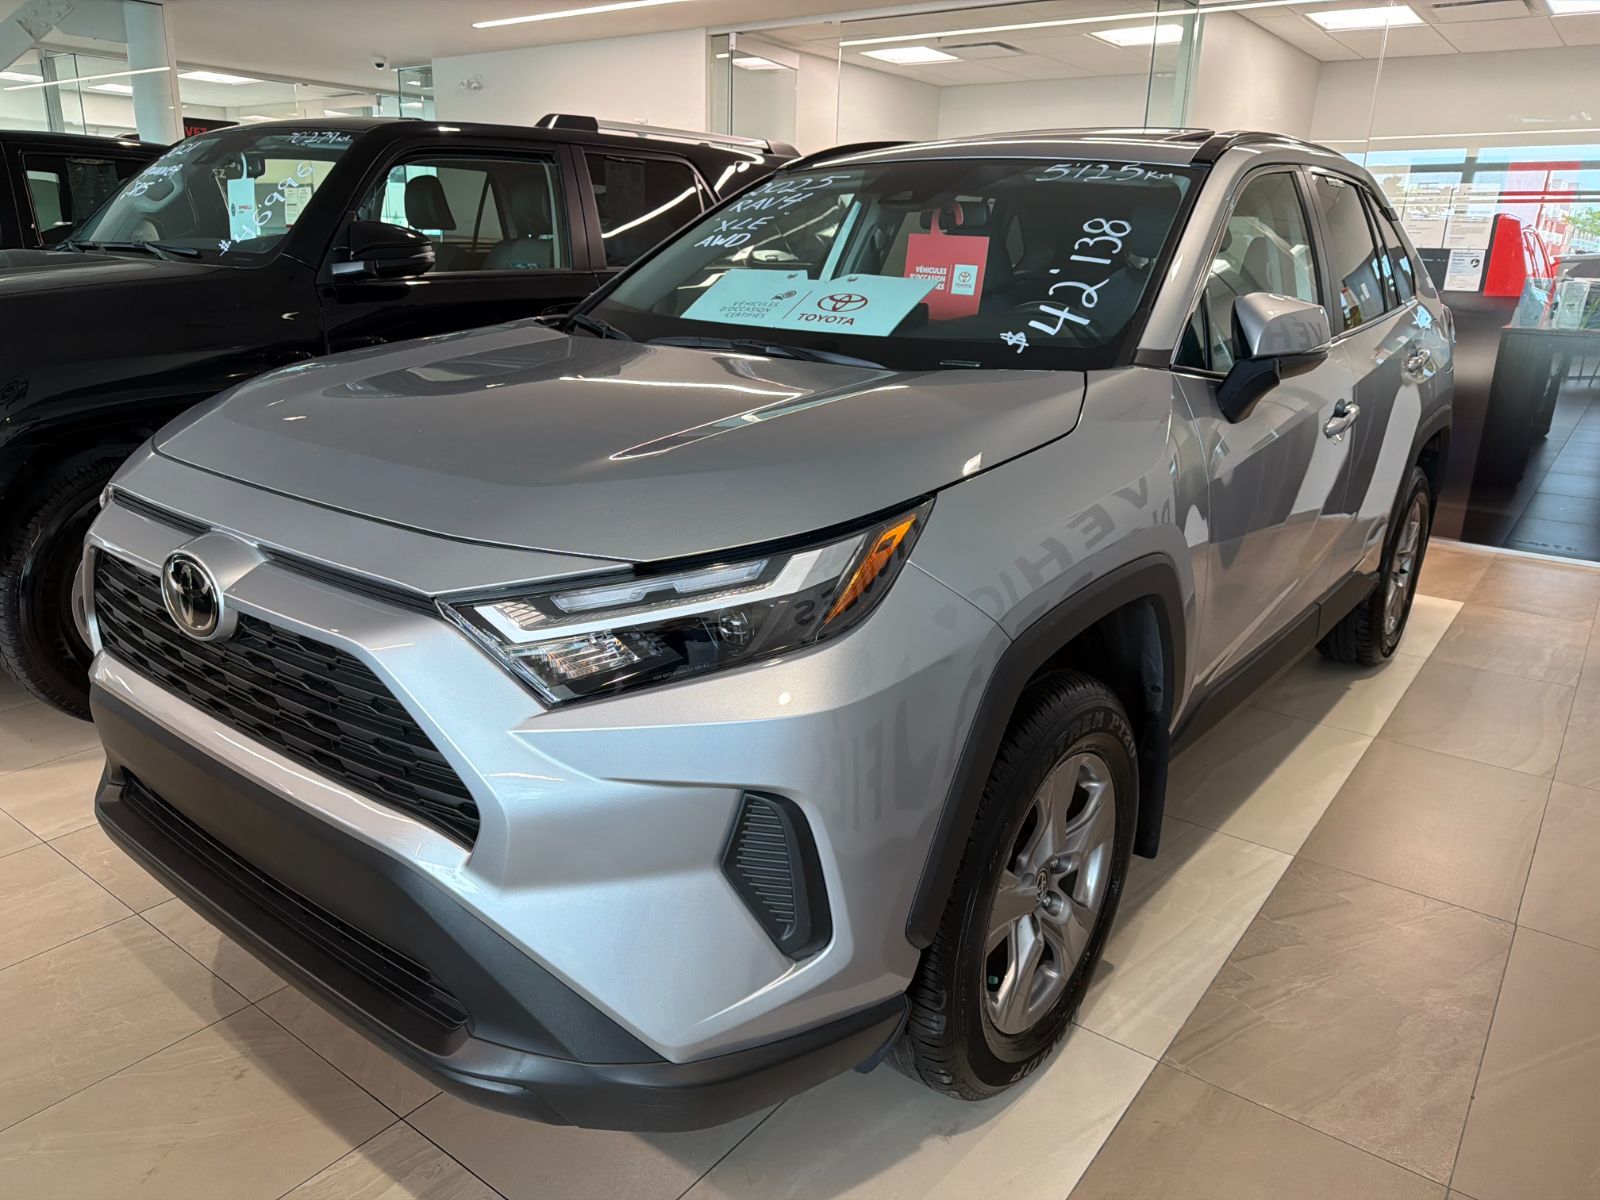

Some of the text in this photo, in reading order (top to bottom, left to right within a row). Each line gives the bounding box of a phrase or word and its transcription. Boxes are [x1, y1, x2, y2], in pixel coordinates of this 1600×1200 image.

[728, 192, 814, 213] RAV4
[694, 233, 751, 248] AWD
[797, 313, 855, 325] TOYOTA
